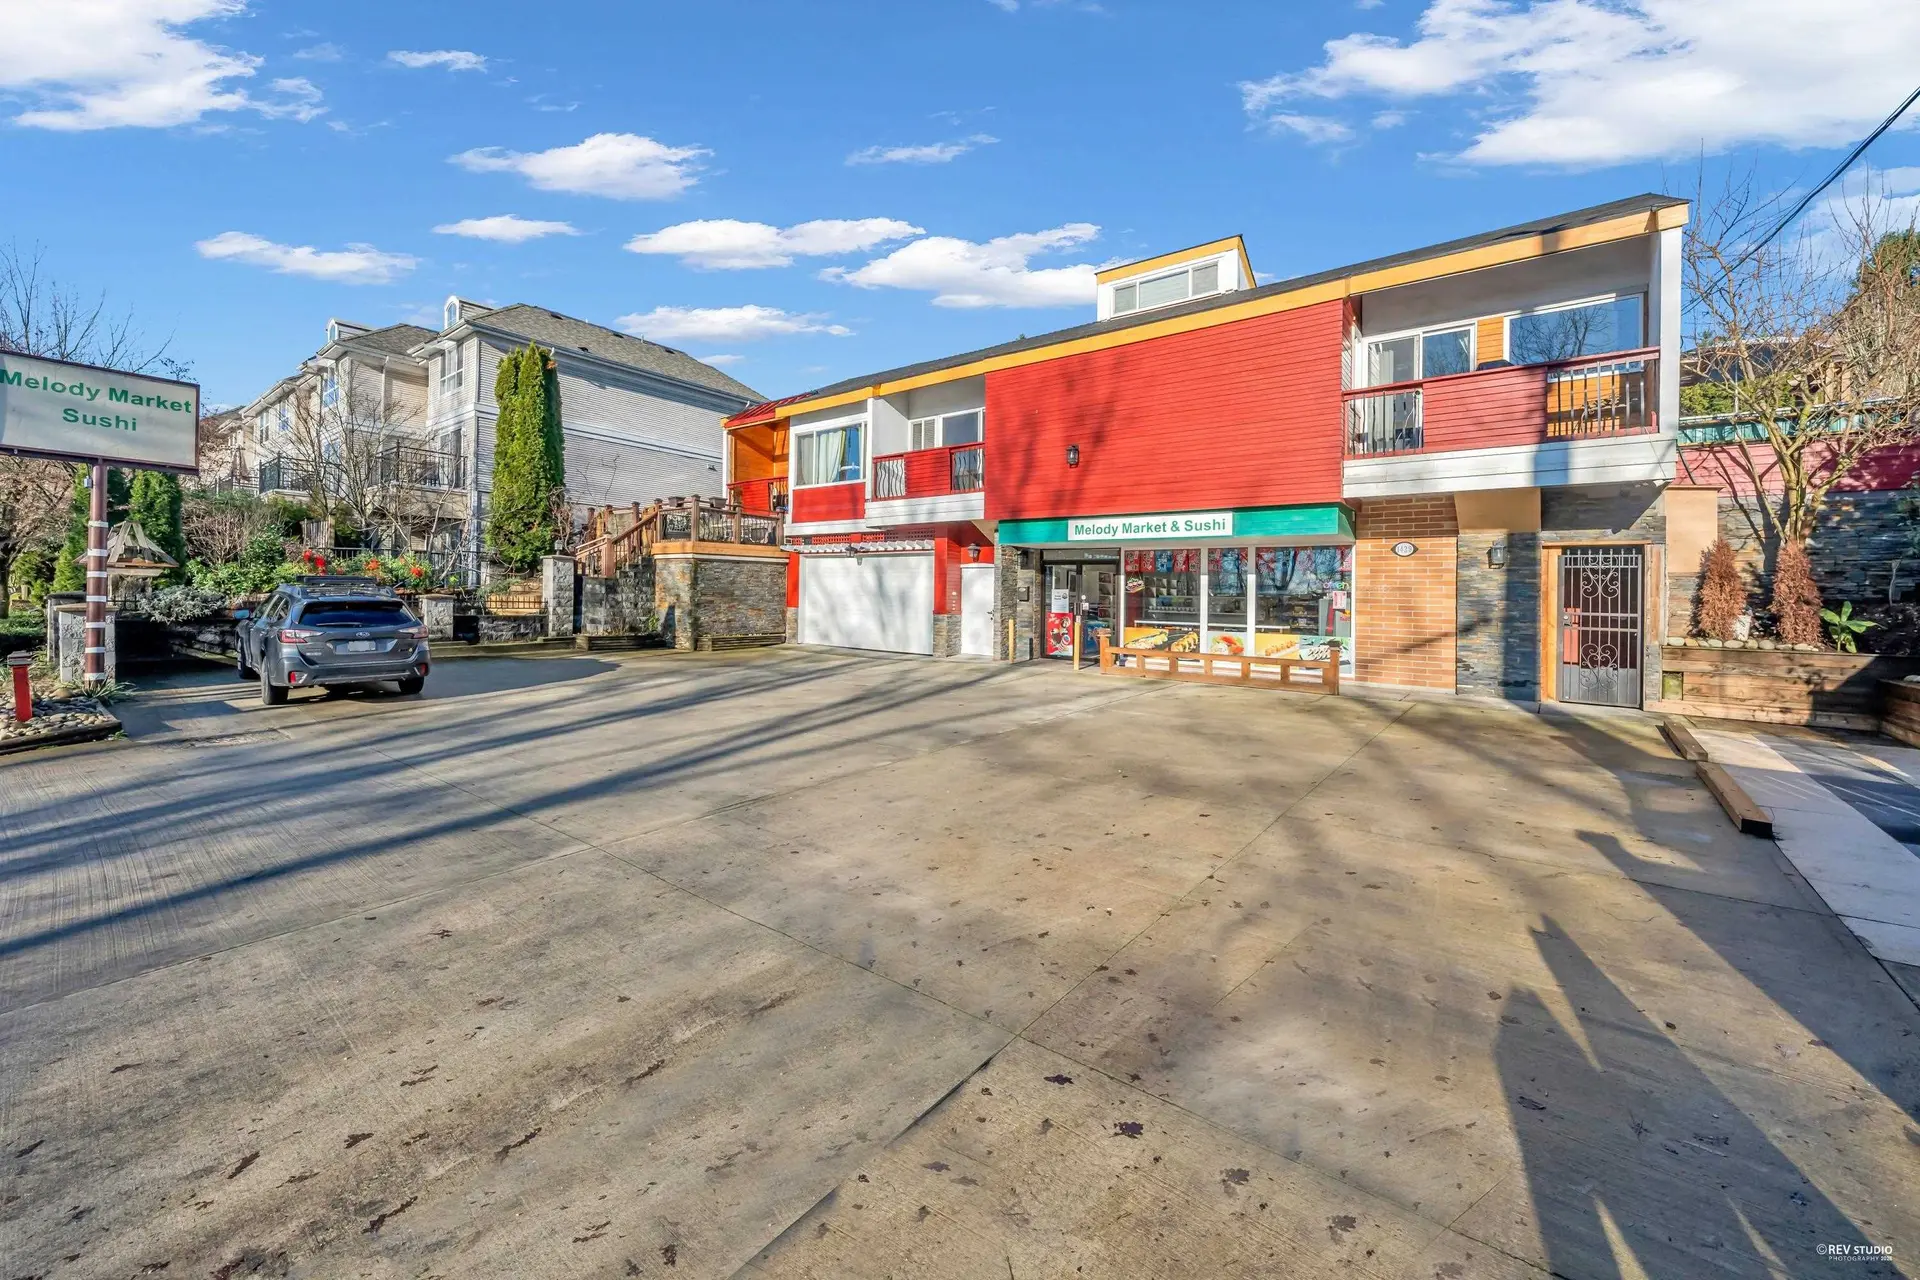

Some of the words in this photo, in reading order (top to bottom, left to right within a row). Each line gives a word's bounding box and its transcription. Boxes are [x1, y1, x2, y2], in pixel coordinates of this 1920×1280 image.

[0, 369, 100, 401] Melody
[109, 388, 192, 413] Market
[62, 408, 137, 431] Sushi
[1074, 524, 1118, 537] Melody
[1122, 522, 1167, 534] Market
[1170, 520, 1180, 532] &
[1184, 518, 1226, 532] Sushi
